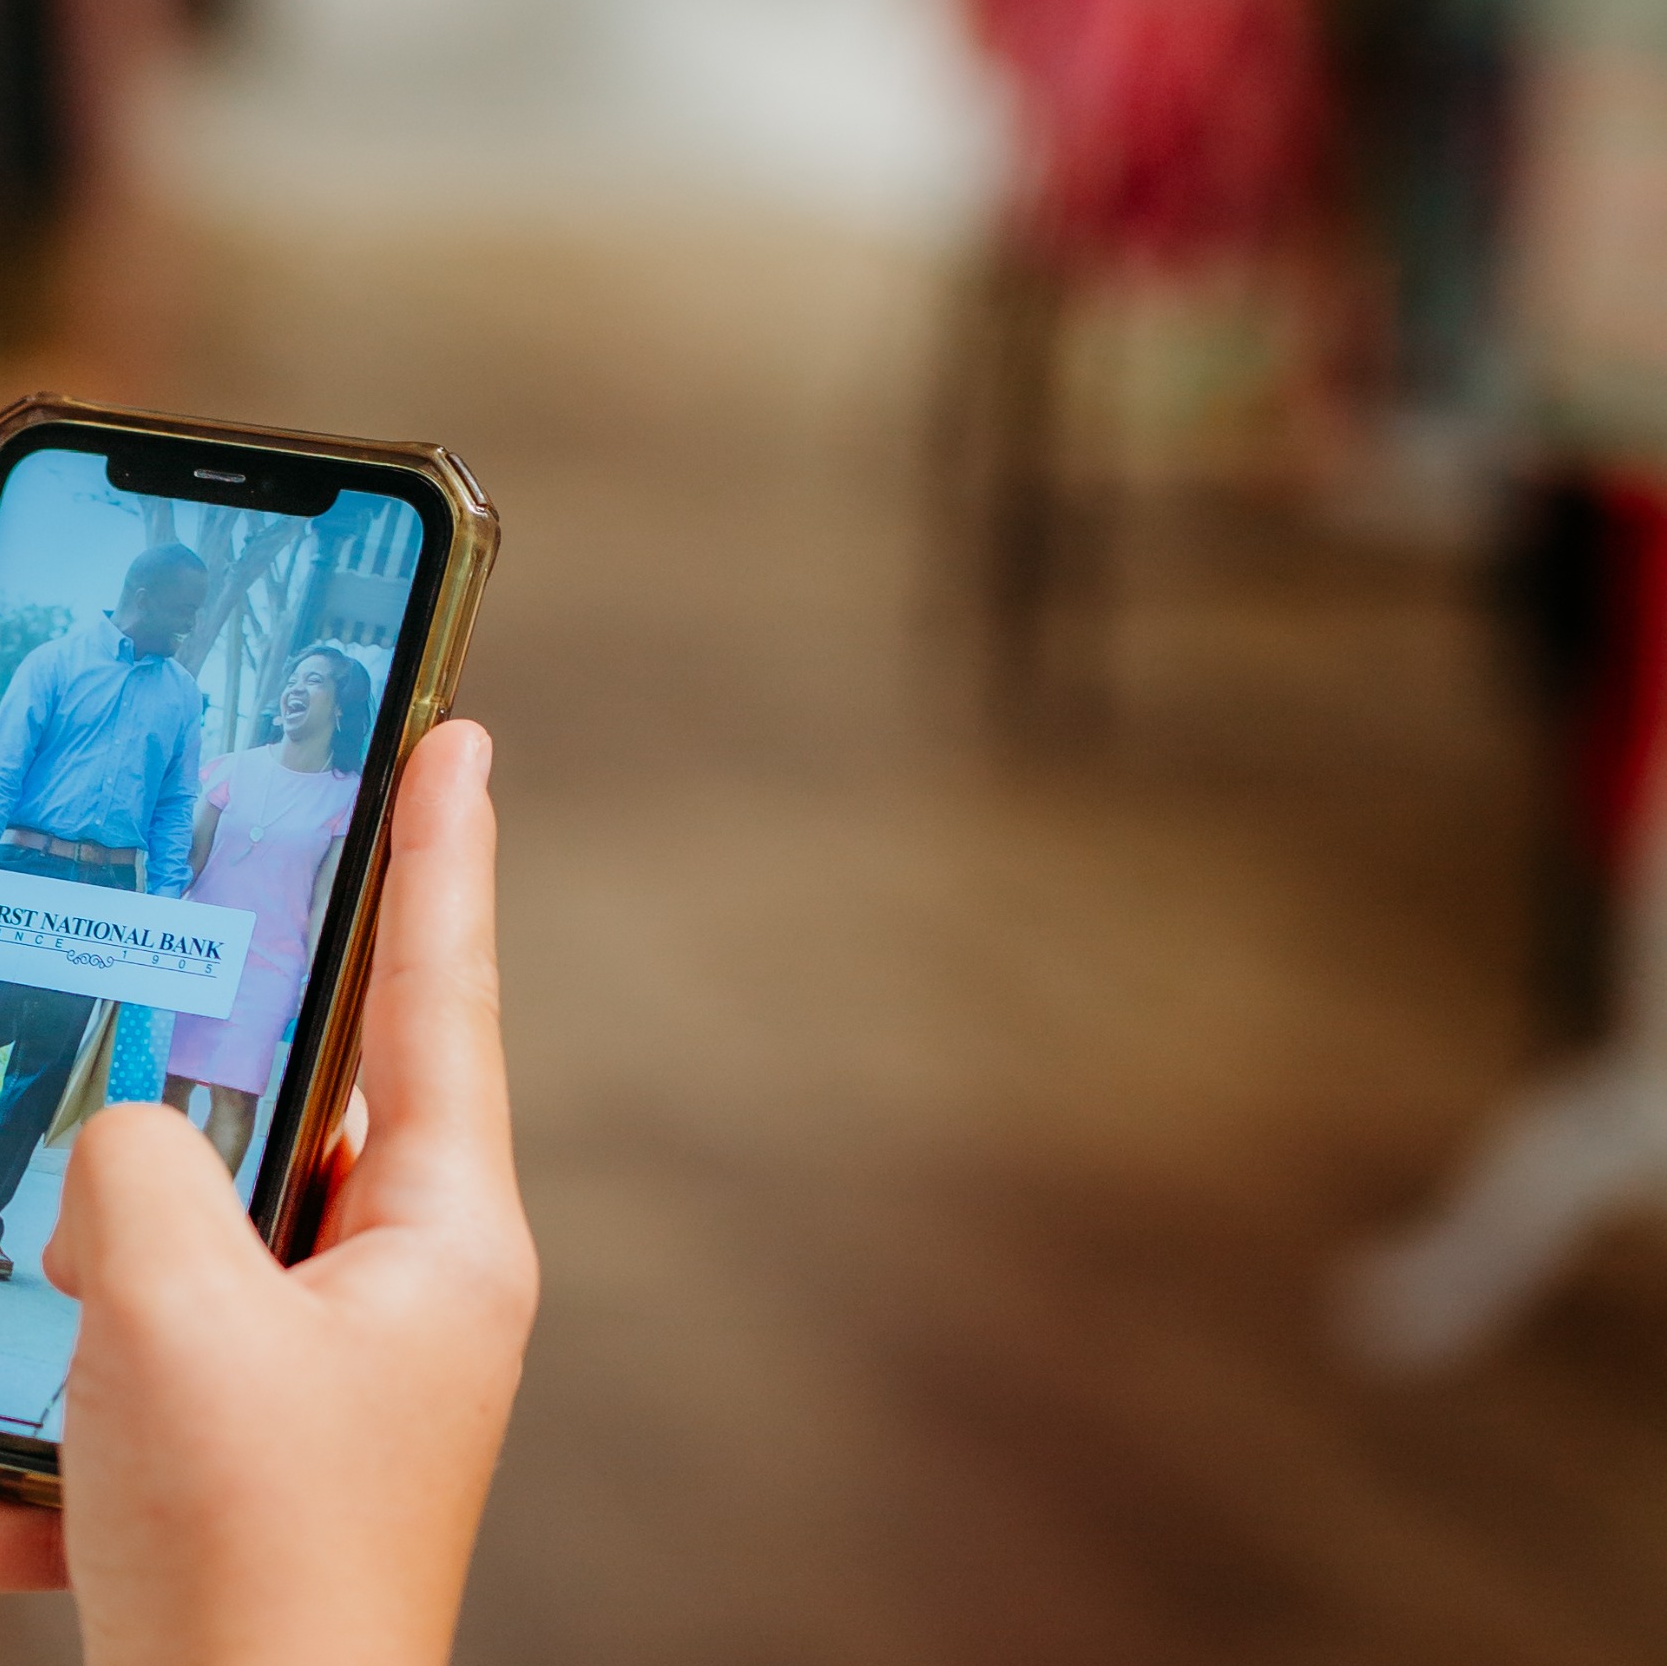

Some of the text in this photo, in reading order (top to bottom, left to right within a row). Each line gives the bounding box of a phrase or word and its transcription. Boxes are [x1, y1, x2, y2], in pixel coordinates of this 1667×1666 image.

[42, 912, 155, 948] NATIONAL
[159, 932, 225, 961] BANK
[122, 950, 214, 974] 1905
